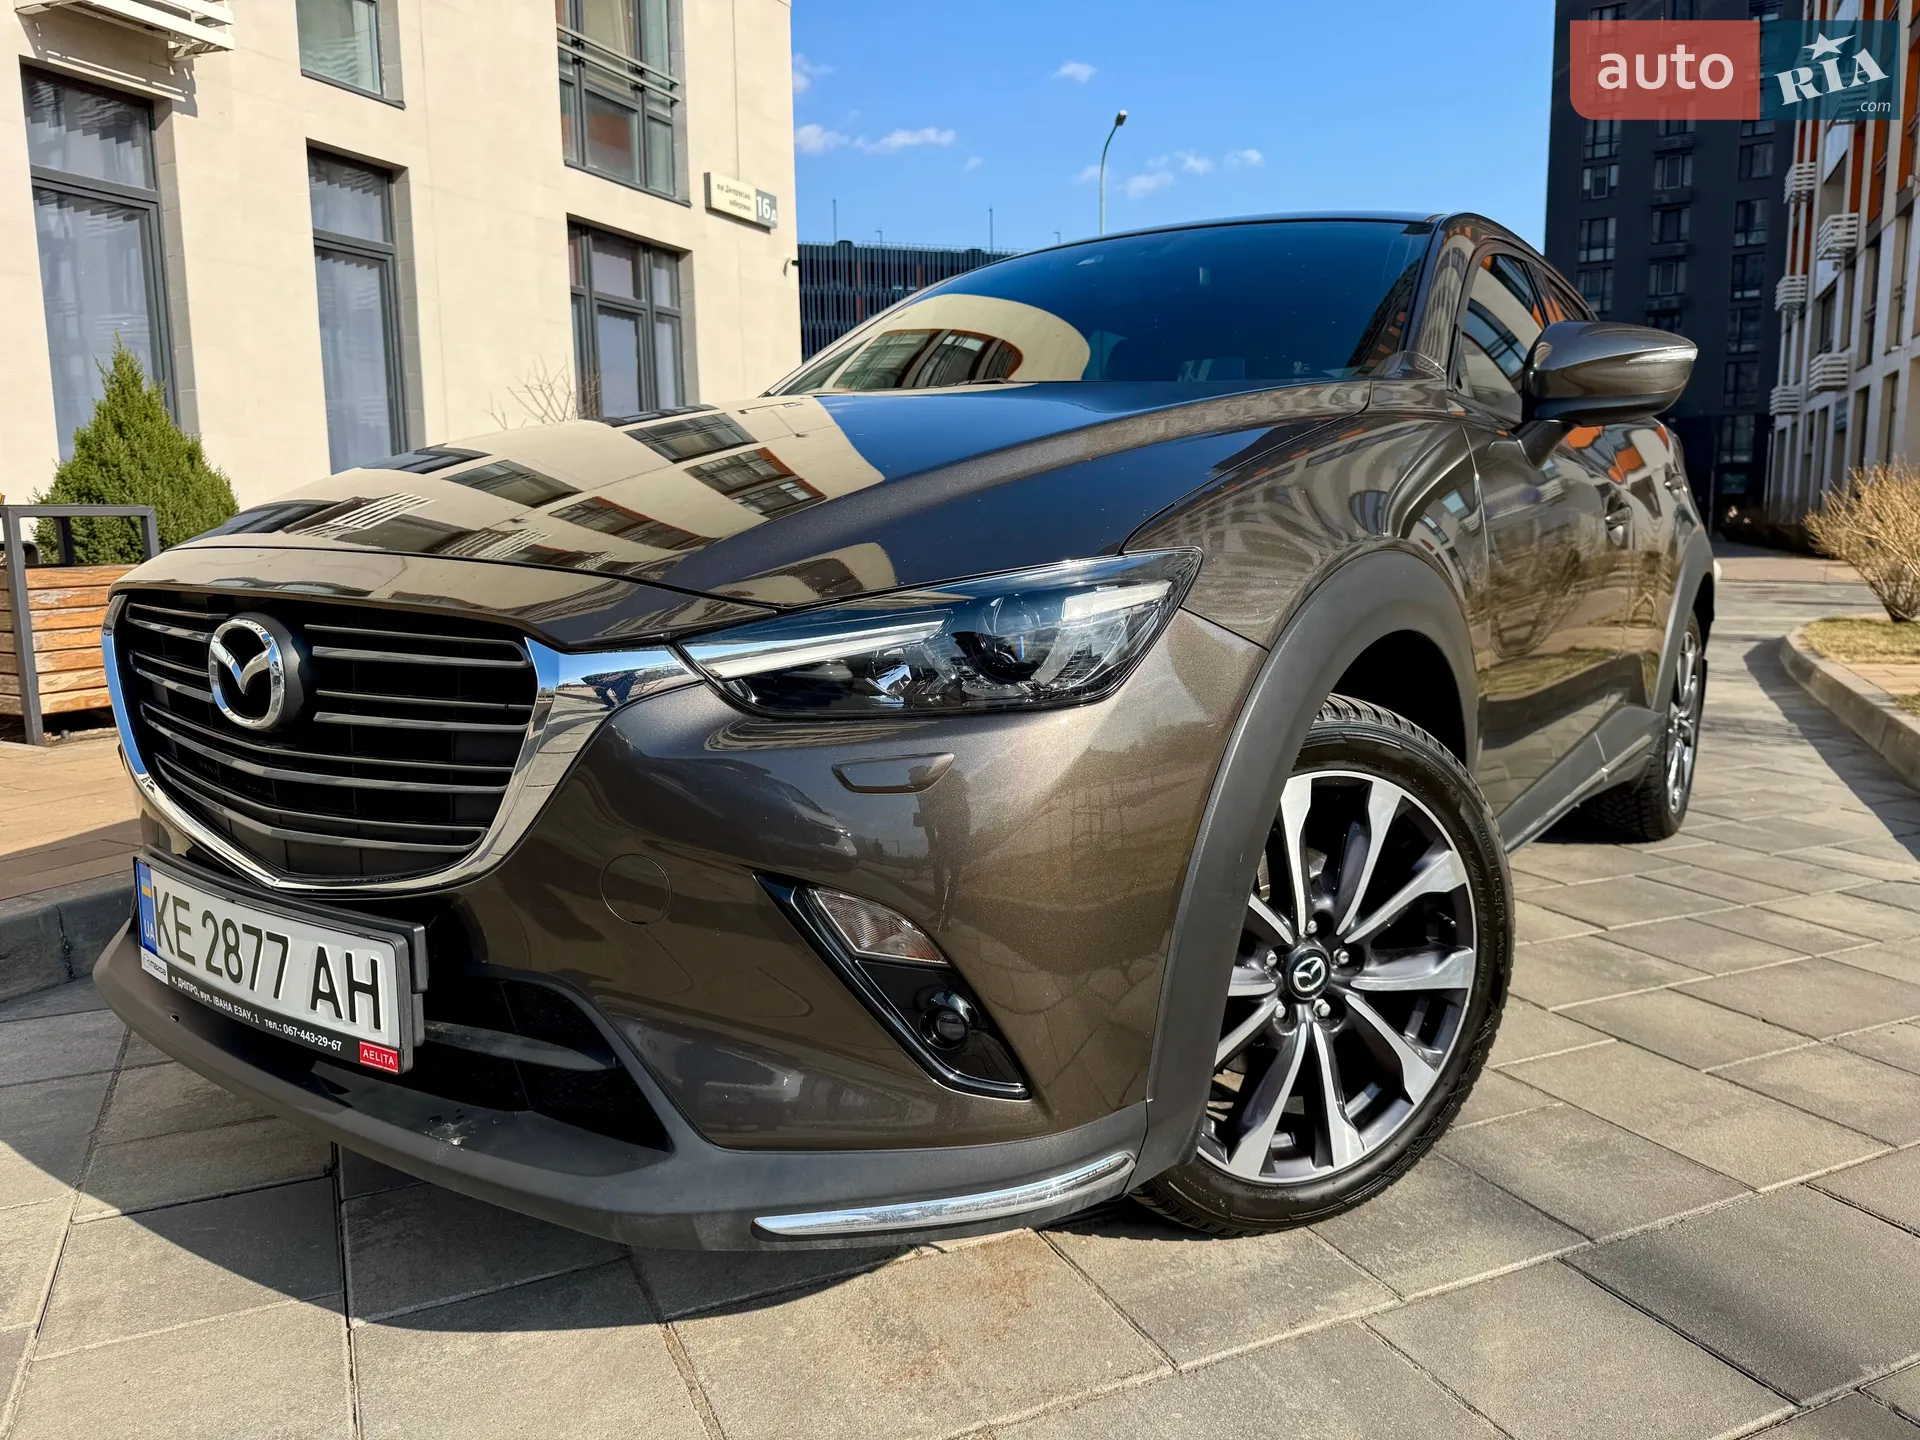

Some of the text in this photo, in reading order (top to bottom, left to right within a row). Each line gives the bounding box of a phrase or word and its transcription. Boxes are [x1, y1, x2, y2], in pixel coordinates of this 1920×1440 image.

[143, 918, 156, 943] UA
[153, 885, 382, 1031] KE 2877 AH
[199, 990, 212, 1002] вул.
[212, 995, 233, 1013] ІВАНА
[254, 1013, 260, 1024] 1
[264, 1019, 282, 1032] тел.:
[282, 1023, 342, 1052] 067-443-29-67
[362, 1048, 395, 1066] AELITA
